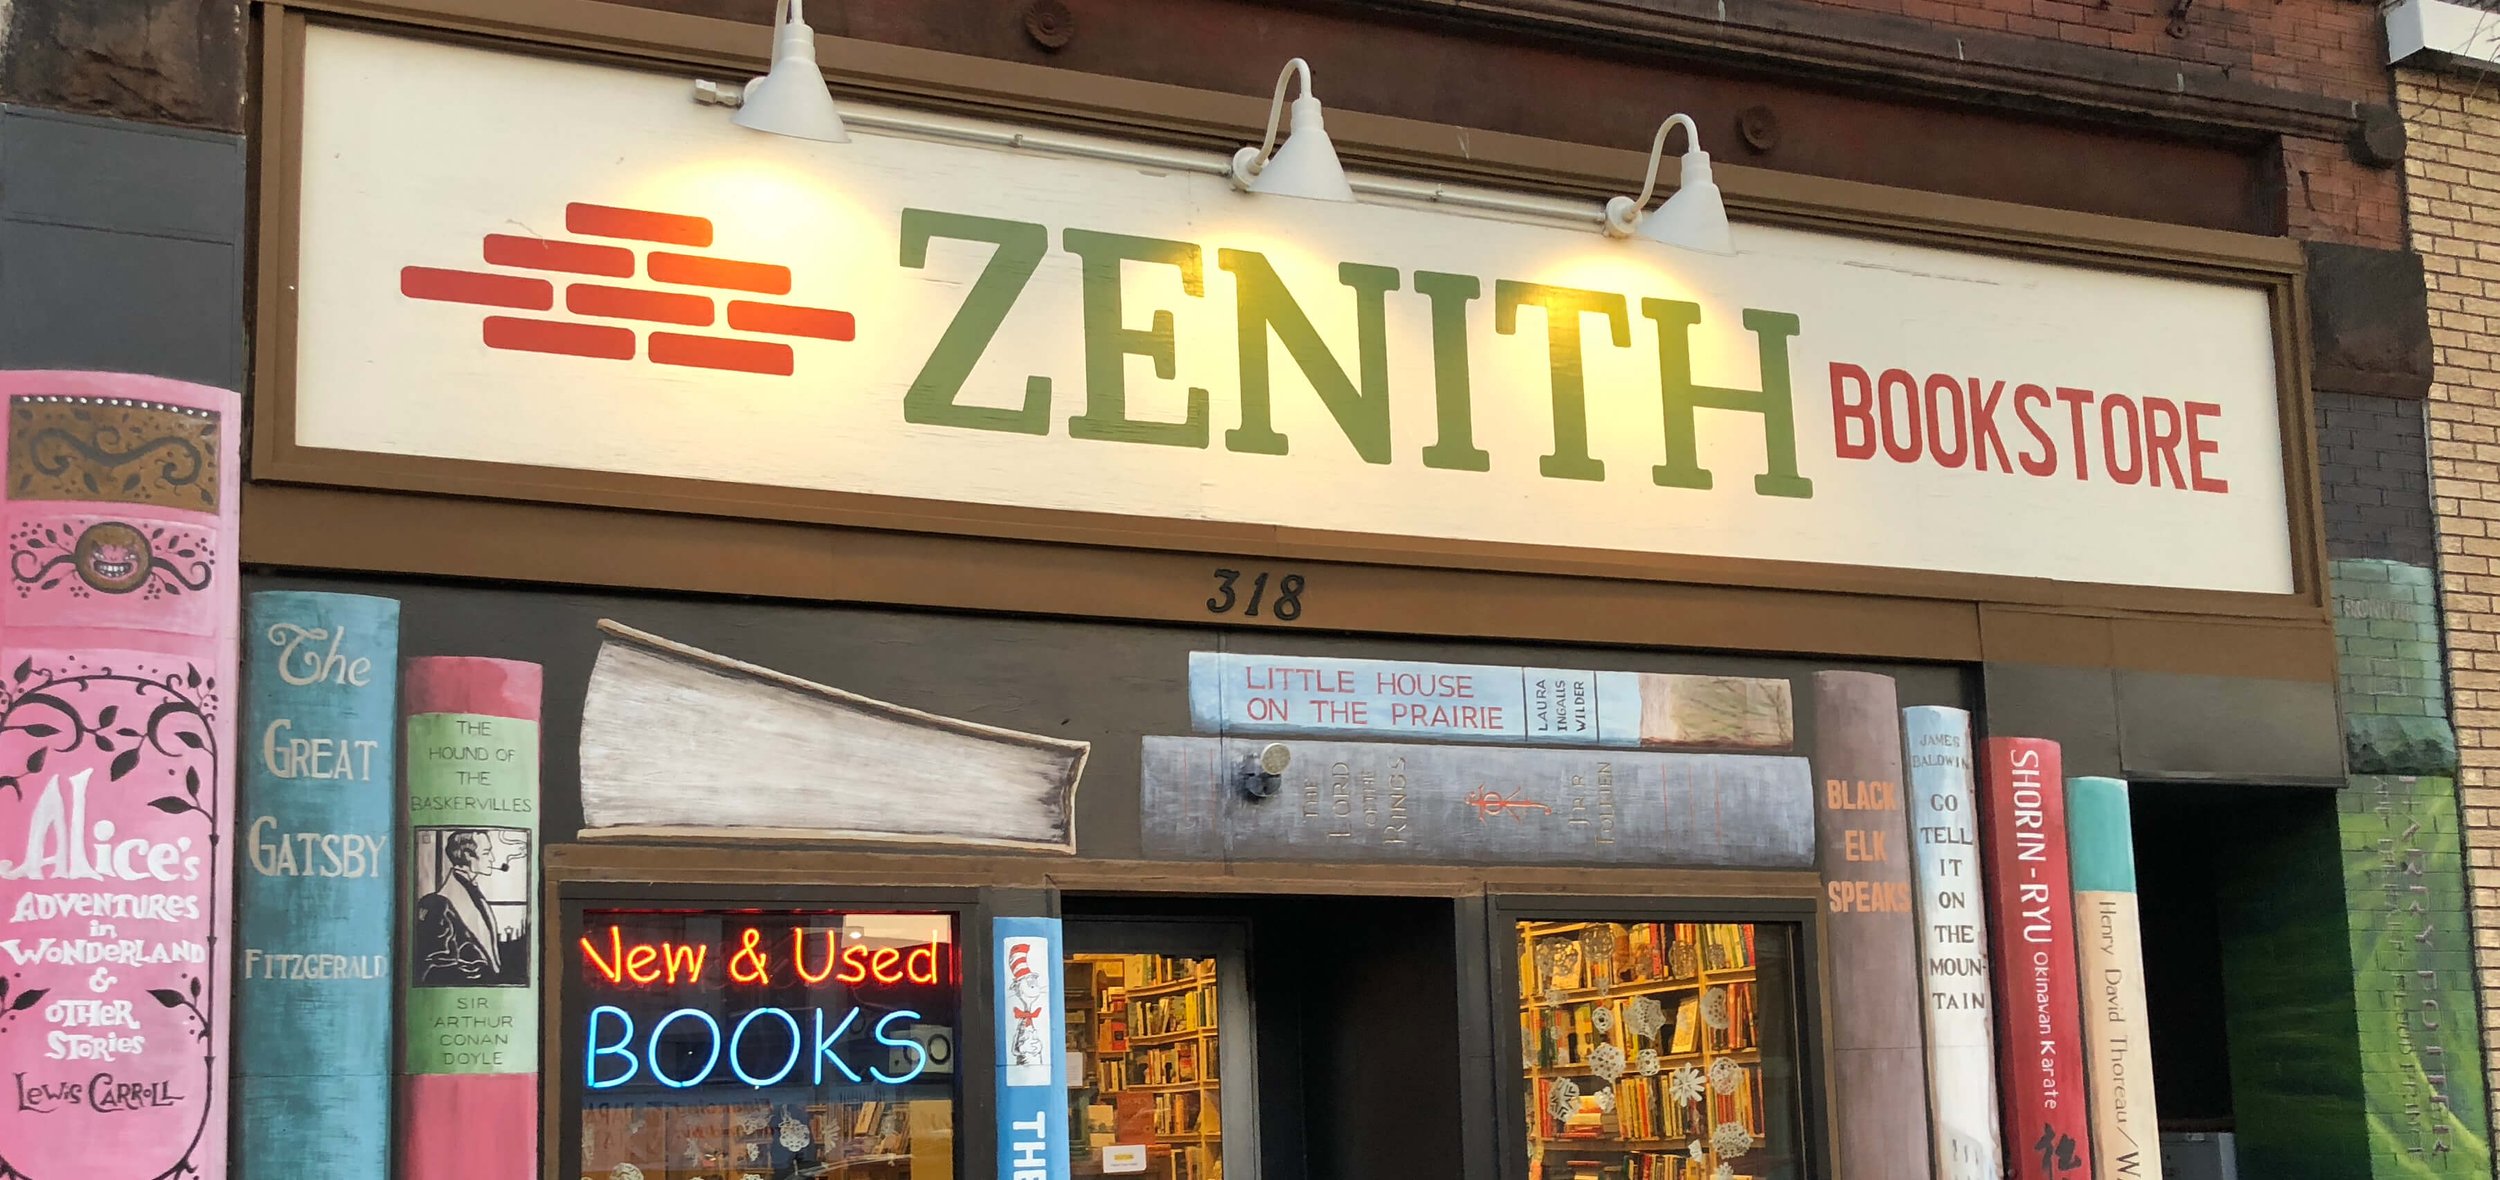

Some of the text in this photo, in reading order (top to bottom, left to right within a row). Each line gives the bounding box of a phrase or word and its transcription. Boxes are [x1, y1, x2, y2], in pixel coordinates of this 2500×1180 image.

[899, 207, 2229, 498] ZENITH BOOKSTORE
[1206, 568, 1306, 621] 318
[268, 622, 372, 687] The
[1245, 666, 1474, 699] LITTLE HOUSE
[1246, 697, 1505, 731] ON THE PRAIRIE
[1535, 678, 1548, 732] LAURA
[1575, 680, 1586, 732] WILDER
[456, 721, 492, 738] THE
[1919, 732, 1961, 748] JAMES
[263, 718, 379, 781] GREAT
[429, 747, 516, 763] HOUND OF
[1912, 754, 1970, 770] BALDWIN
[456, 770, 492, 785] THE
[411, 795, 533, 814] BASKERVILLES
[1327, 761, 1351, 840] LORD
[1382, 757, 1408, 846] RINGS
[1827, 779, 1897, 811] BLACK
[1931, 794, 1959, 812] GO
[249, 816, 388, 879] GATSBY
[1845, 830, 1888, 862] ELK
[1921, 827, 1973, 845] TELL
[1940, 859, 1963, 877] IT
[1828, 880, 1912, 913] SPEAKS
[1938, 890, 1965, 910] ON
[89, 919, 117, 938] in
[1934, 925, 1975, 944] THE
[2099, 901, 2117, 957] Henry
[244, 949, 388, 980] FITZGERALD
[727, 926, 771, 987] &
[793, 926, 939, 986] Used
[1930, 957, 1988, 977] MOUN-
[89, 966, 117, 993] &
[2104, 967, 2126, 1023] David
[457, 996, 489, 1010] SIR
[1931, 992, 1985, 1010] TAIN
[434, 1014, 515, 1030] ARTHUR
[439, 1032, 509, 1048] CONAN
[585, 1005, 928, 1089] BOOKS
[443, 1051, 503, 1066] DOYLE
[2039, 1039, 2058, 1110] Karate
